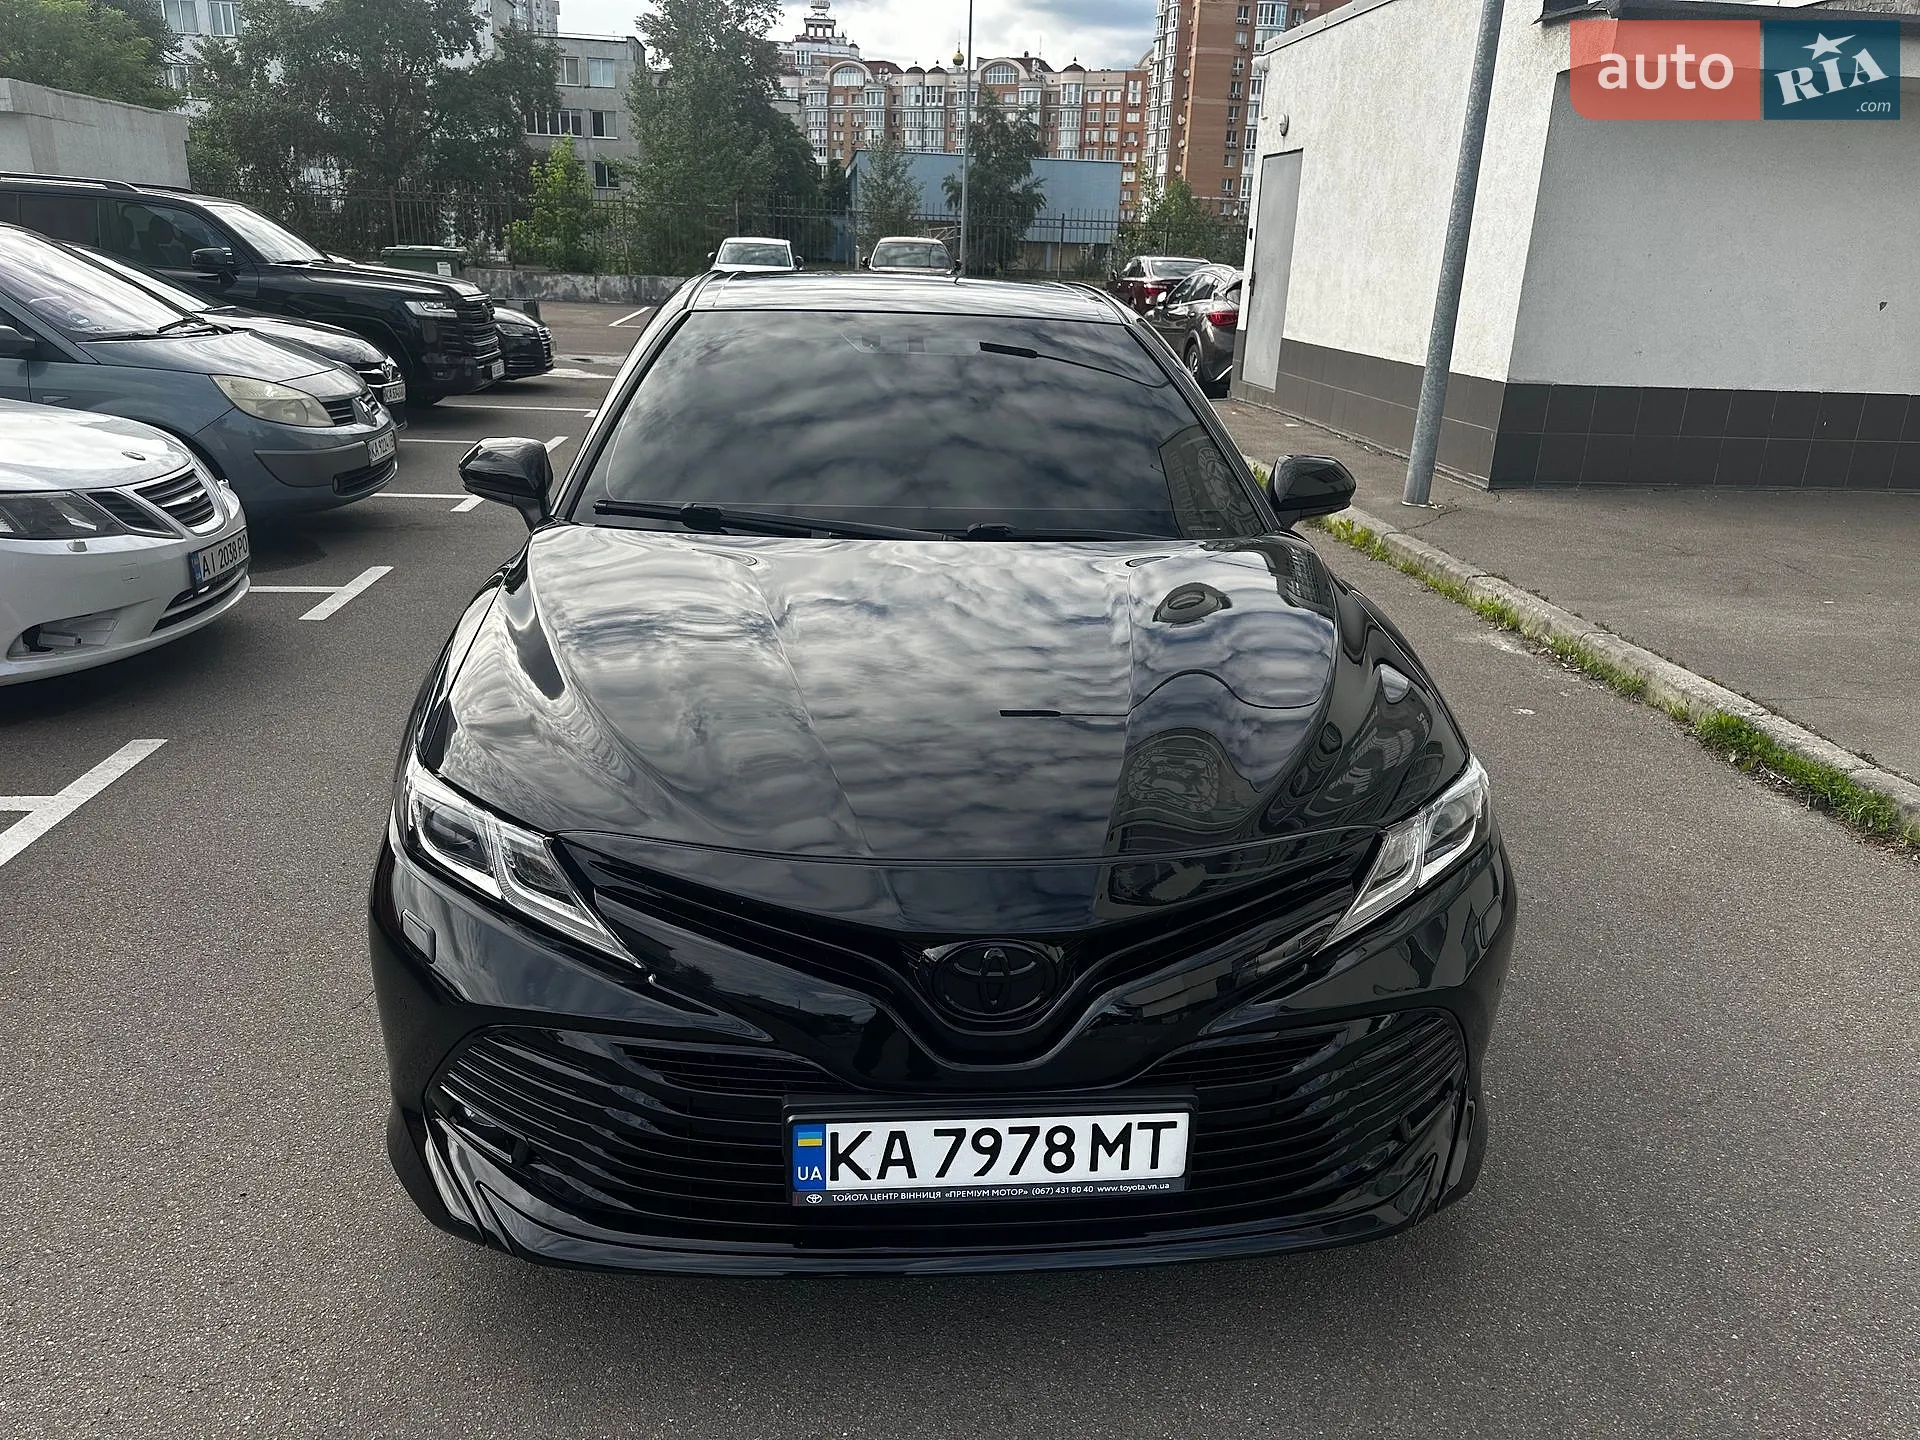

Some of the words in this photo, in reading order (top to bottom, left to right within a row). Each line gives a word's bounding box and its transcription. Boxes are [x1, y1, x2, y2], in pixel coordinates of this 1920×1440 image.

[203, 552, 215, 578] AI
[218, 541, 237, 569] 2038
[237, 534, 248, 558] PO
[829, 1130, 918, 1181] KA
[933, 1125, 1076, 1178] 7978
[1089, 1121, 1178, 1172] MT
[797, 1166, 822, 1181] UA
[832, 1193, 869, 1202] ТОЙОТА
[871, 1192, 899, 1202] ЦЕНТР
[900, 1191, 941, 1200] ВІННИЦЯ
[945, 1189, 989, 1199] «ПРЕМІУМ
[991, 1188, 1028, 1197] МОТОР»
[1031, 1187, 1054, 1196] (067)
[1055, 1186, 1071, 1194] 431
[1071, 1186, 1082, 1194] 80
[1083, 1185, 1094, 1193] 40
[1097, 1183, 1170, 1193] www.toyota.vn.ua
